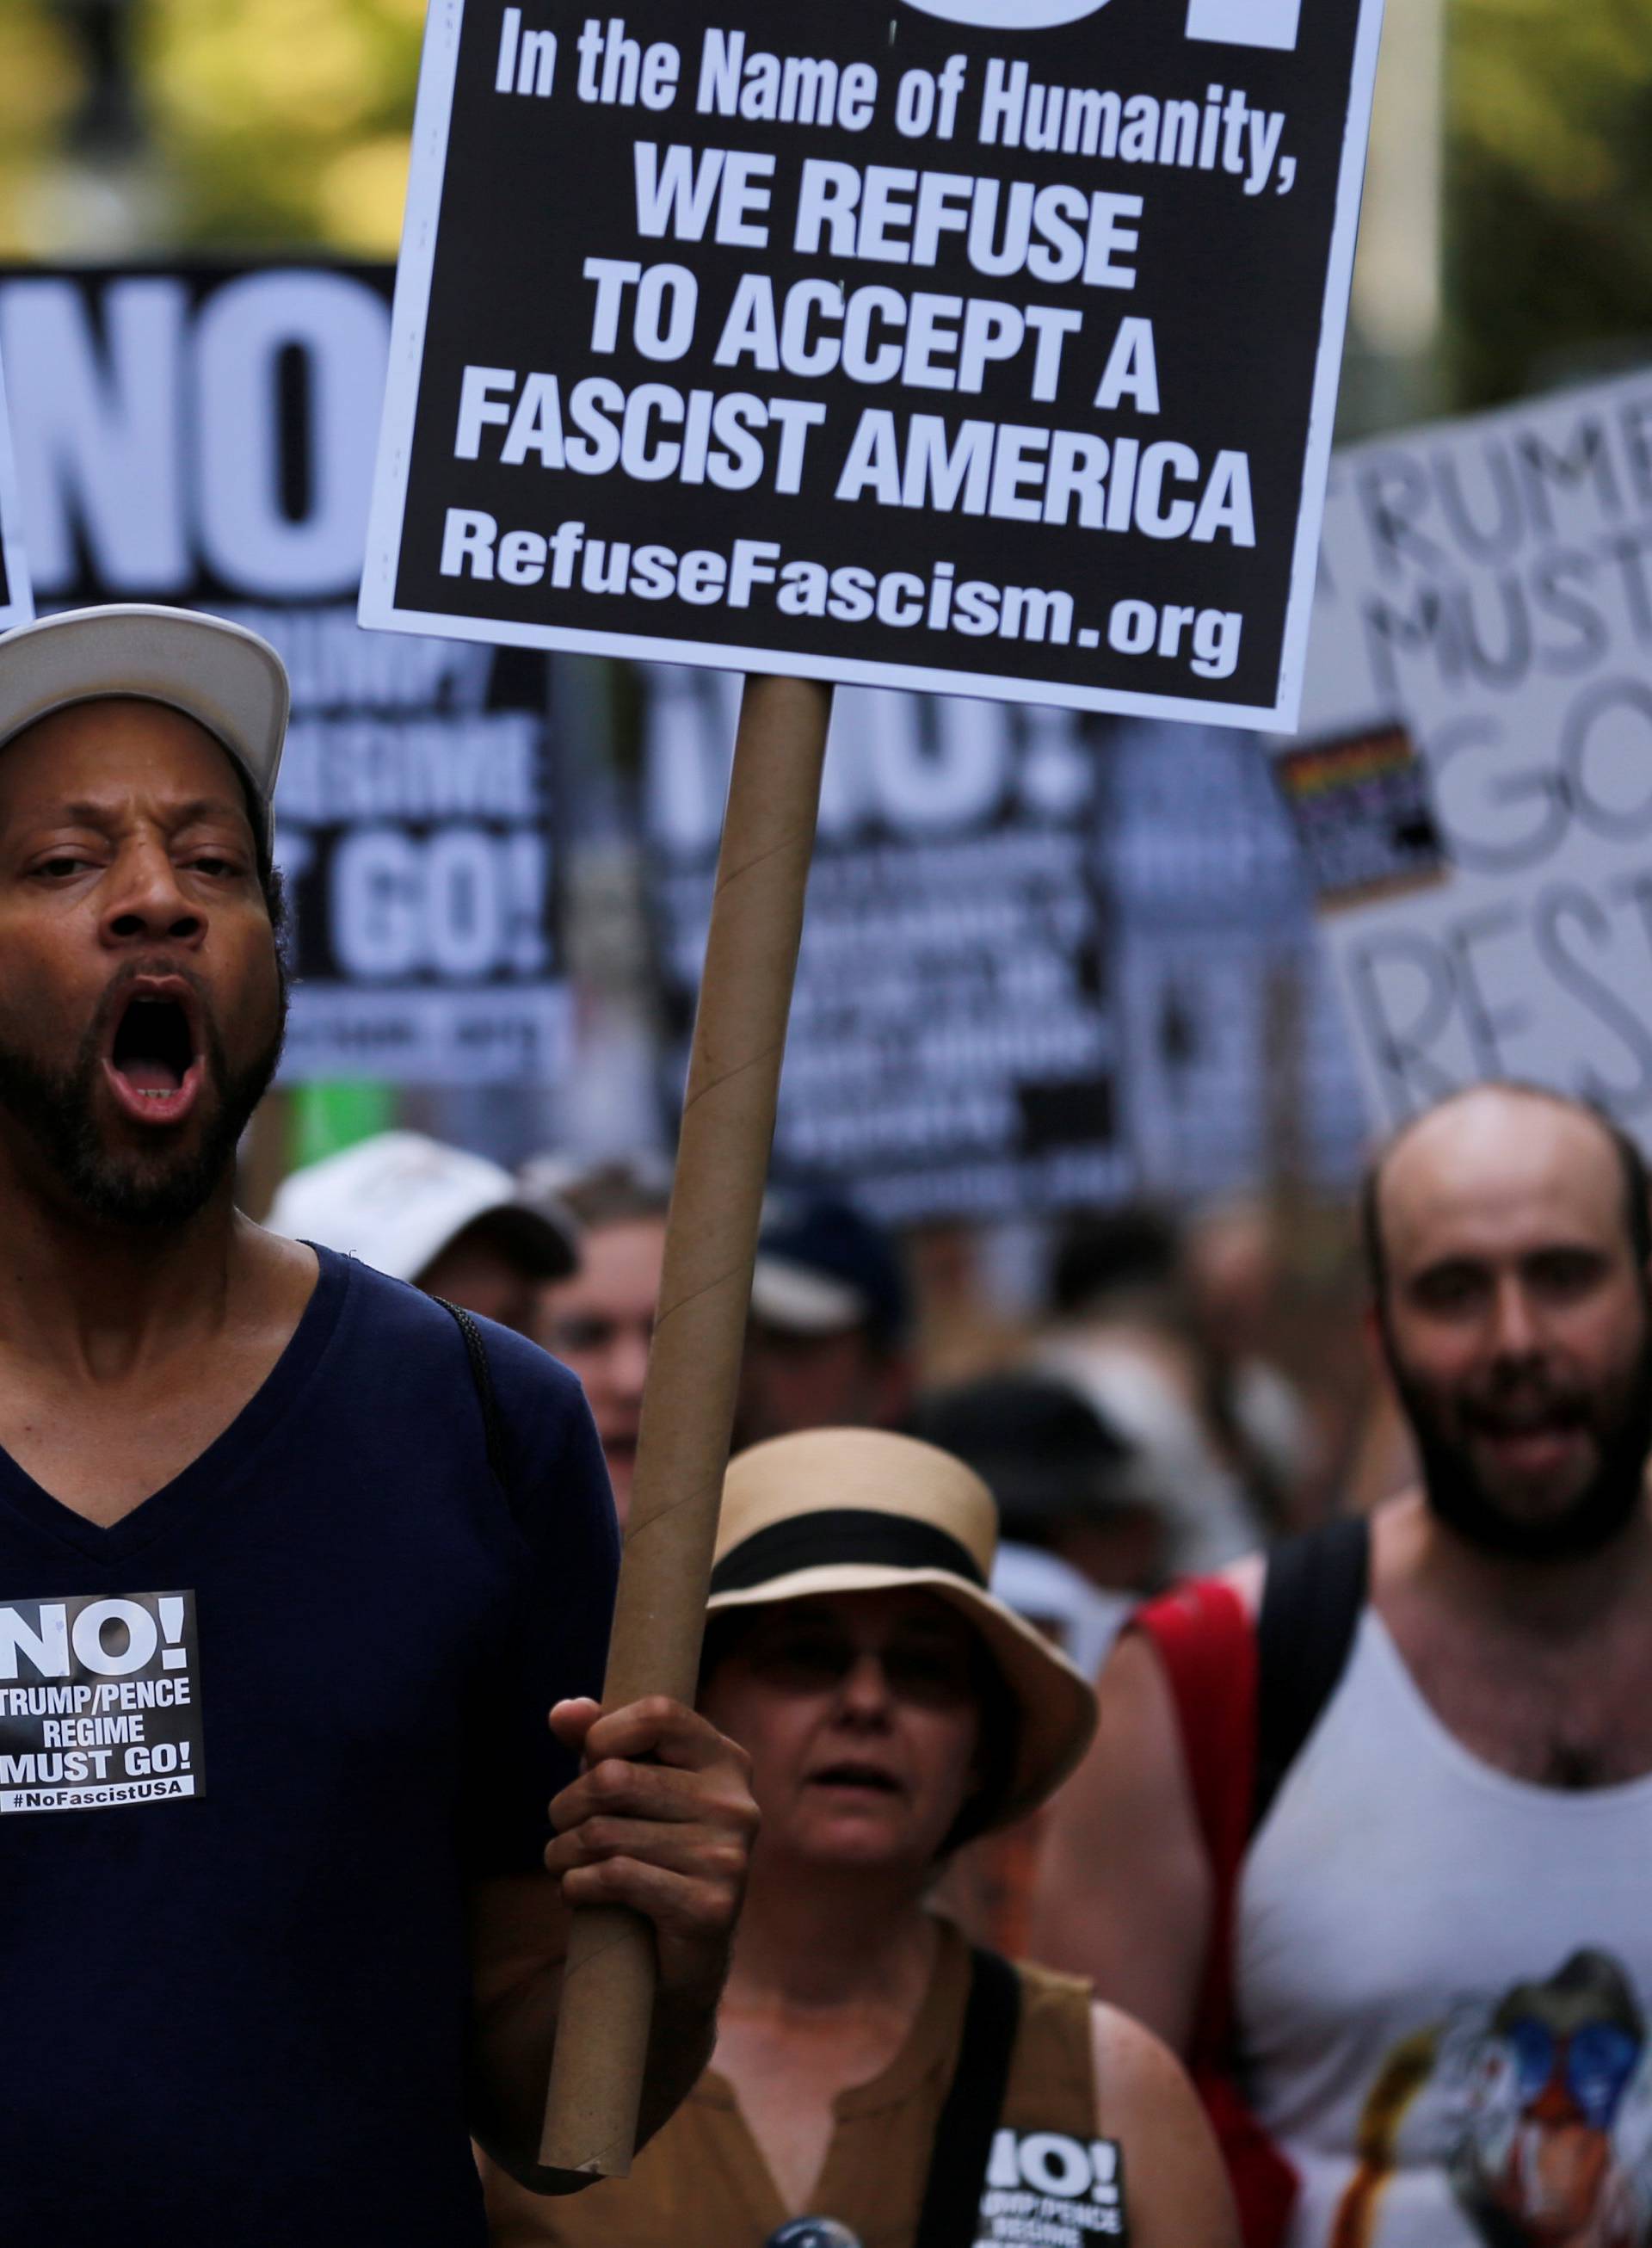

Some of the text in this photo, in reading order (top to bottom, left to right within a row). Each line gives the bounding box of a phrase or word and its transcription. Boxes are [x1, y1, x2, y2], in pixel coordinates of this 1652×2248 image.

[496, 7, 1297, 196] In the Name of Humanity,
[634, 140, 1143, 290] WE REFUSE
[583, 257, 1160, 414] TO ACCEPT A
[0, 277, 392, 594] NO
[454, 365, 1256, 547] FASCIST AMERICA
[1319, 401, 1652, 602] RUM
[440, 508, 1242, 679] RefuseFascism.org
[1429, 674, 1652, 874] GO
[330, 826, 549, 978] GO!
[0, 1596, 188, 1679] NO!
[0, 1677, 191, 1716] TRUMP/PENCE
[0, 1741, 191, 1784] MUST GO!
[14, 1780, 182, 1807] #NoFascistUSA
[43, 1714, 145, 1748] REGIME
